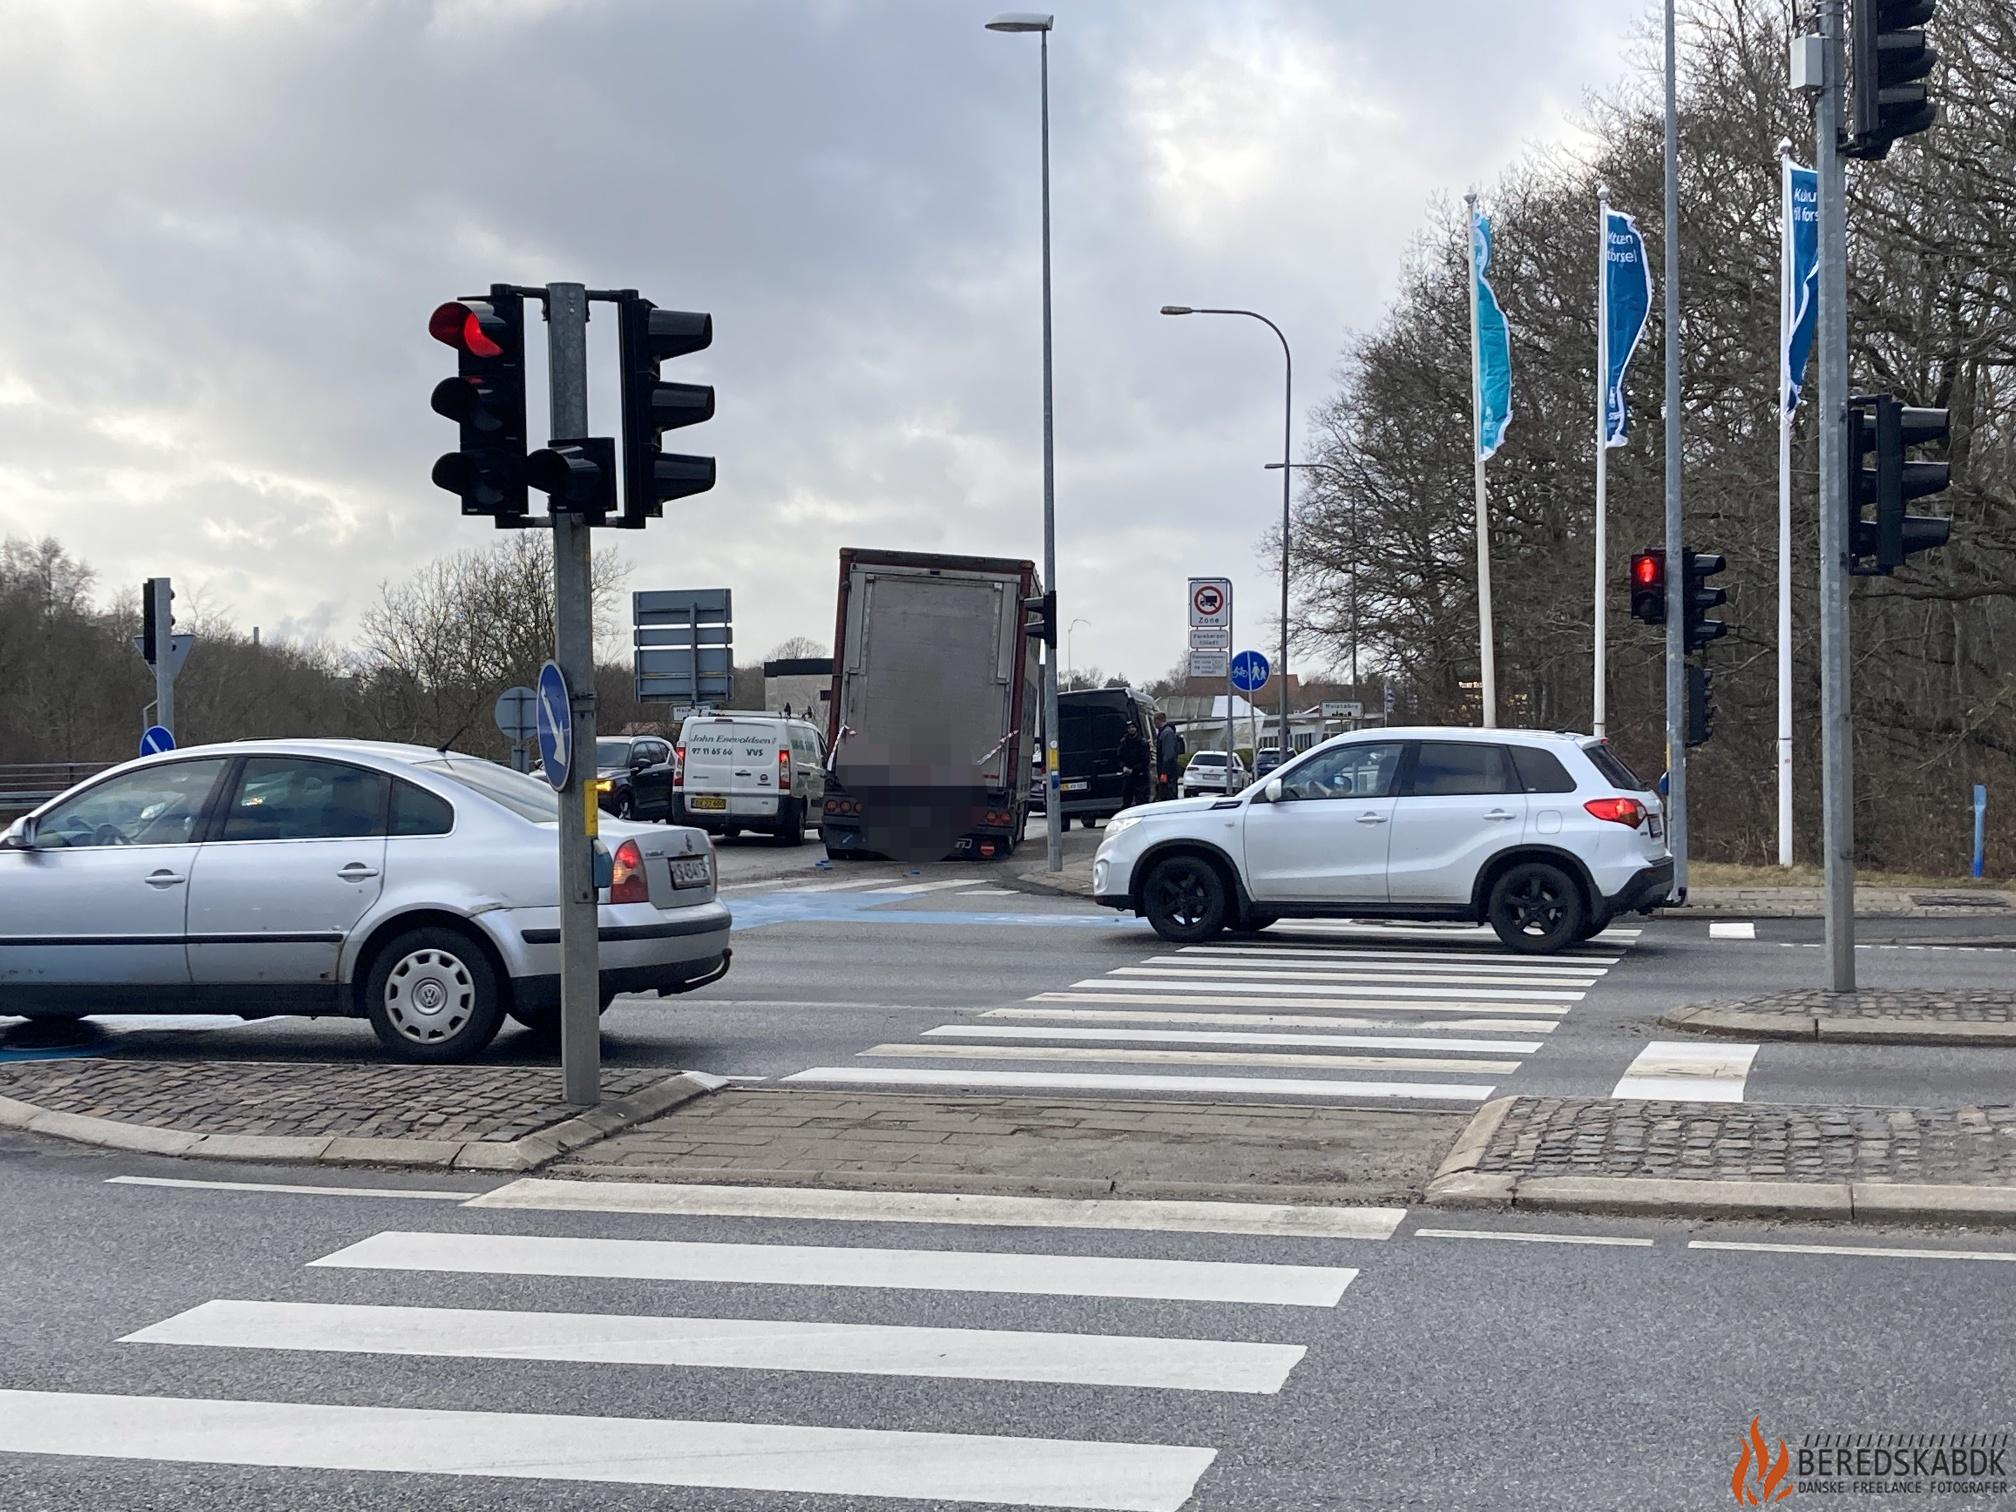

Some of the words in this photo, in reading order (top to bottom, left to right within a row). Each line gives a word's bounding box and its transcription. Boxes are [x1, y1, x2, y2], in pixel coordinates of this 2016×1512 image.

[1198, 616, 1220, 624] Zone
[690, 734, 714, 743] John
[716, 734, 771, 745] Enevoldsen
[691, 747, 701, 755] 97
[711, 747, 721, 756] 65
[745, 748, 764, 757] VVS
